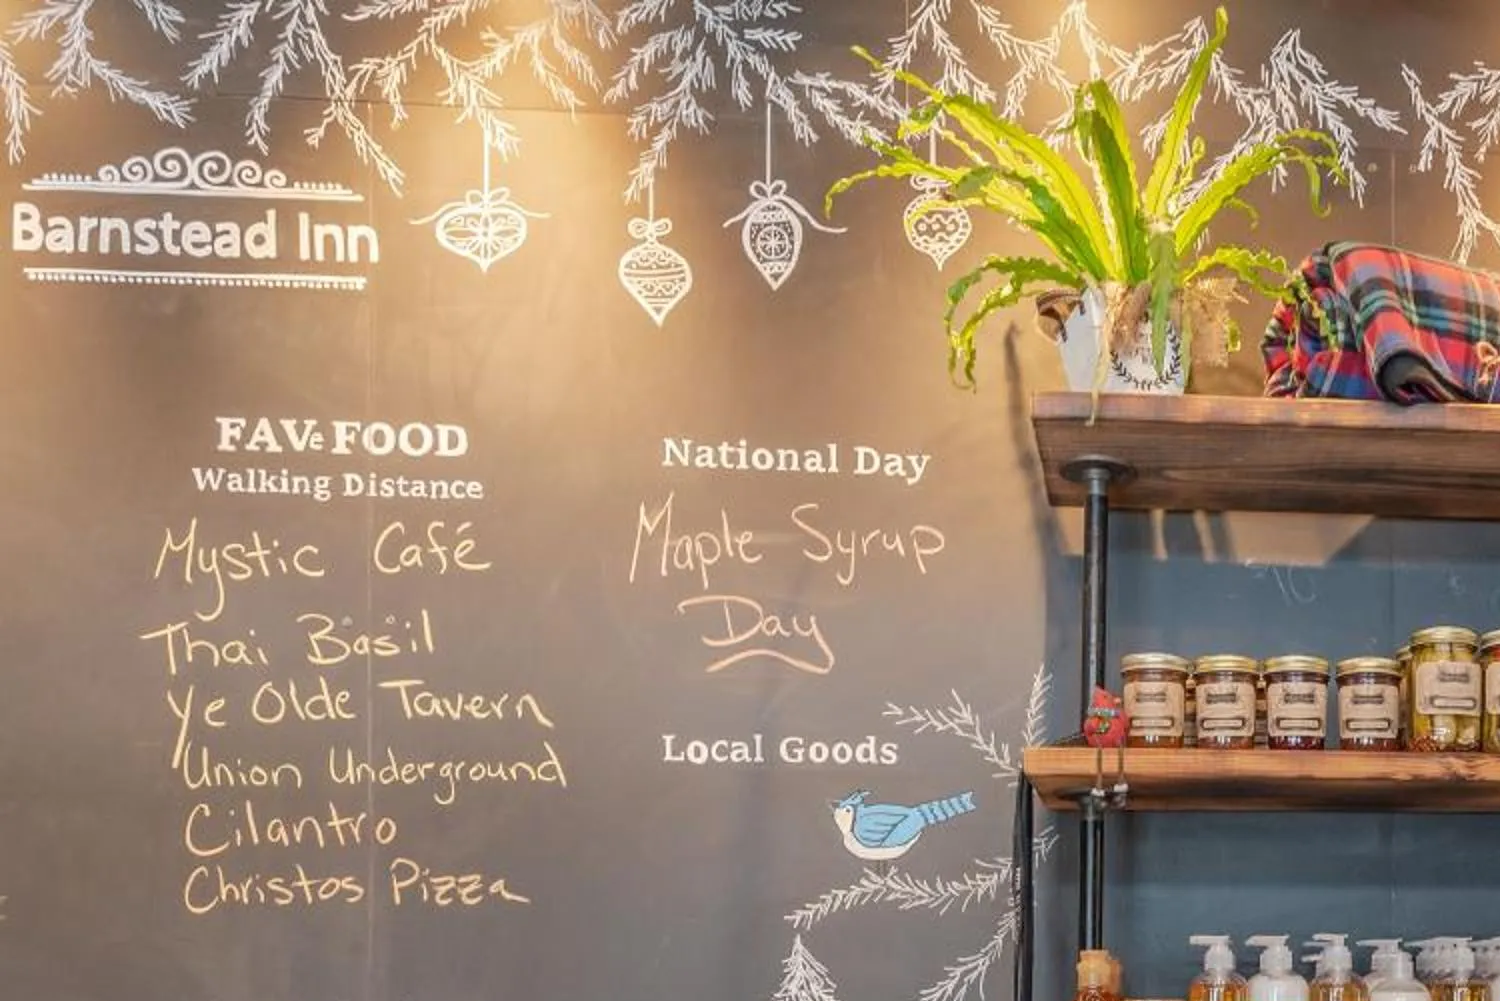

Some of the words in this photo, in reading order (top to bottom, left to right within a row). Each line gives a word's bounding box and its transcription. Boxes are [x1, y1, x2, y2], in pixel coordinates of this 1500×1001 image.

[12, 202, 278, 259] Barnstead
[299, 212, 379, 264] Inn
[331, 420, 469, 457] FOOD
[662, 437, 839, 475] National
[853, 446, 932, 486] Day
[192, 467, 332, 500] Walking
[342, 473, 484, 500] Distance
[154, 517, 325, 621] Mystic
[374, 521, 492, 575] Café
[629, 492, 763, 590] Maple
[791, 503, 945, 585] Syrup
[139, 621, 270, 675] Thai
[296, 608, 435, 665] Basil
[675, 594, 835, 674] Day
[252, 675, 357, 724] Olde
[378, 679, 555, 728] Tavern
[182, 740, 303, 789] Union
[328, 740, 567, 805] Underground
[662, 734, 765, 765] Local
[779, 735, 900, 765] Goods
[184, 799, 398, 857] Cilantro
[184, 863, 365, 914] Christos
[389, 857, 531, 906] Pizza
